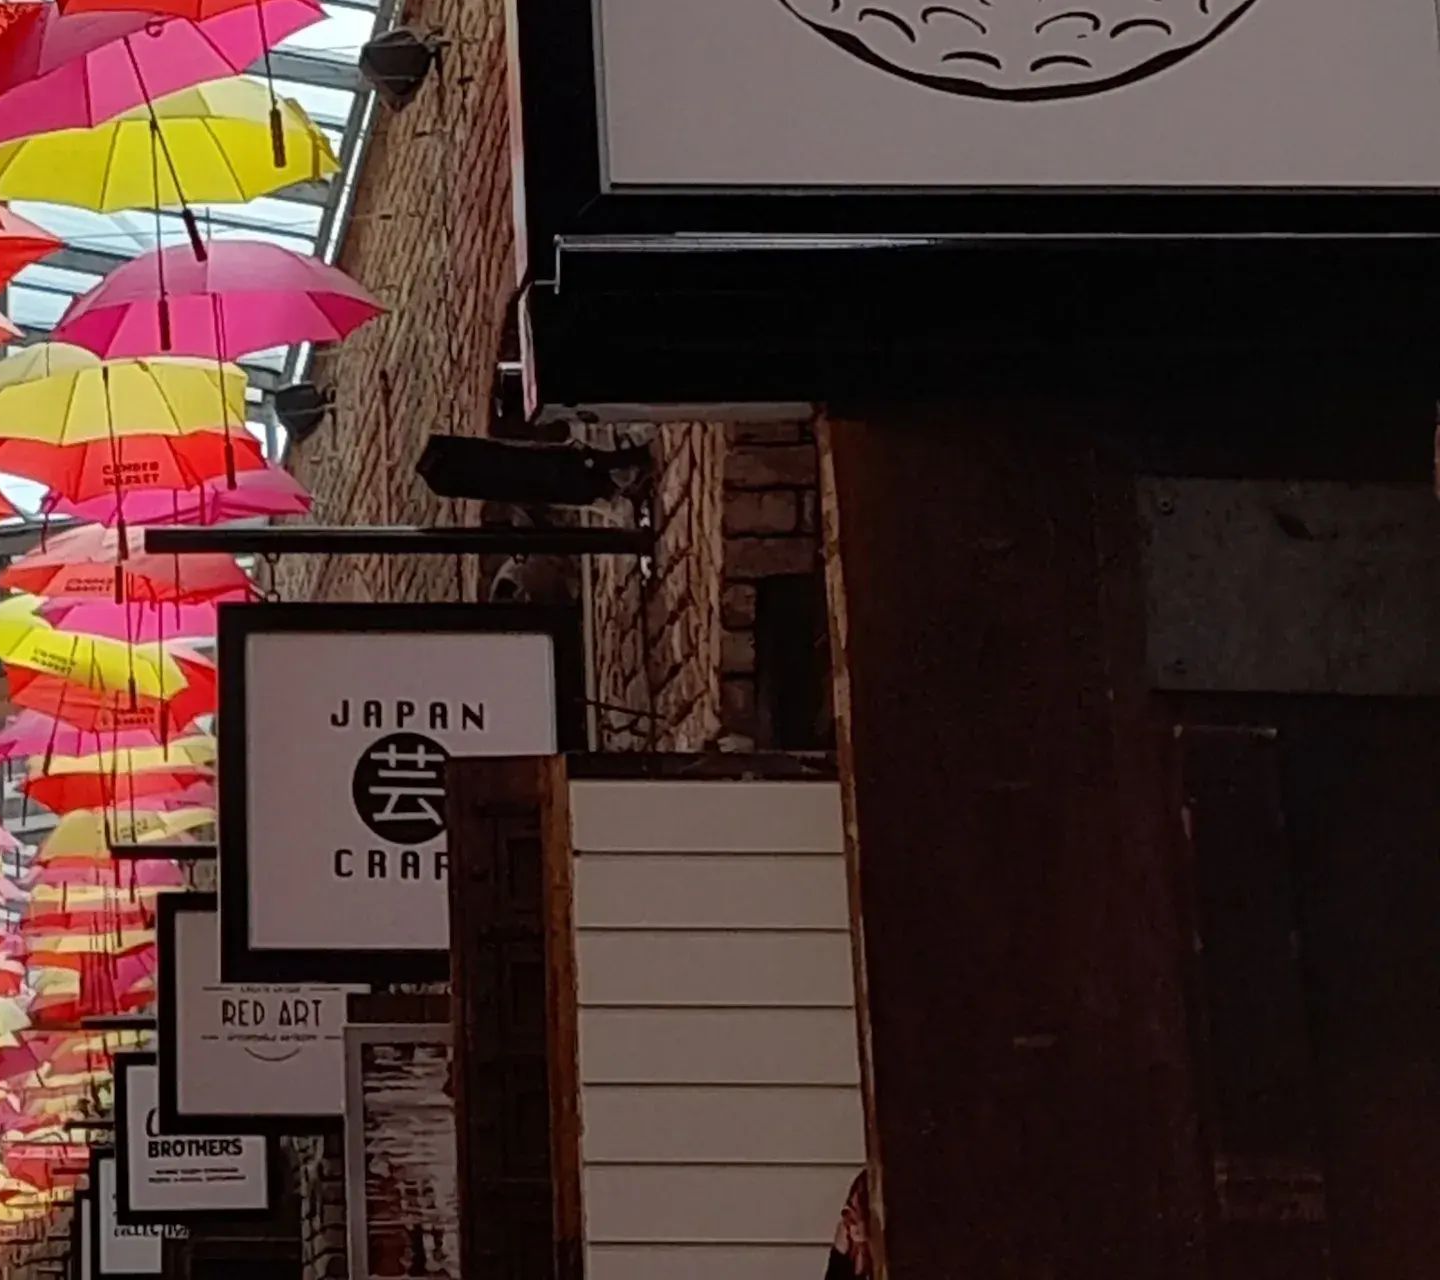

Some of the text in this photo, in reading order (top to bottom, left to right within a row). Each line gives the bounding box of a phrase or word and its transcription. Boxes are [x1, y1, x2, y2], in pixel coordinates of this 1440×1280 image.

[330, 699, 484, 732] JAPAN
[368, 743, 446, 827] 芸
[334, 848, 449, 881] CRAF
[221, 999, 322, 1027] RED ART
[148, 1138, 243, 1159] BROTHERS
